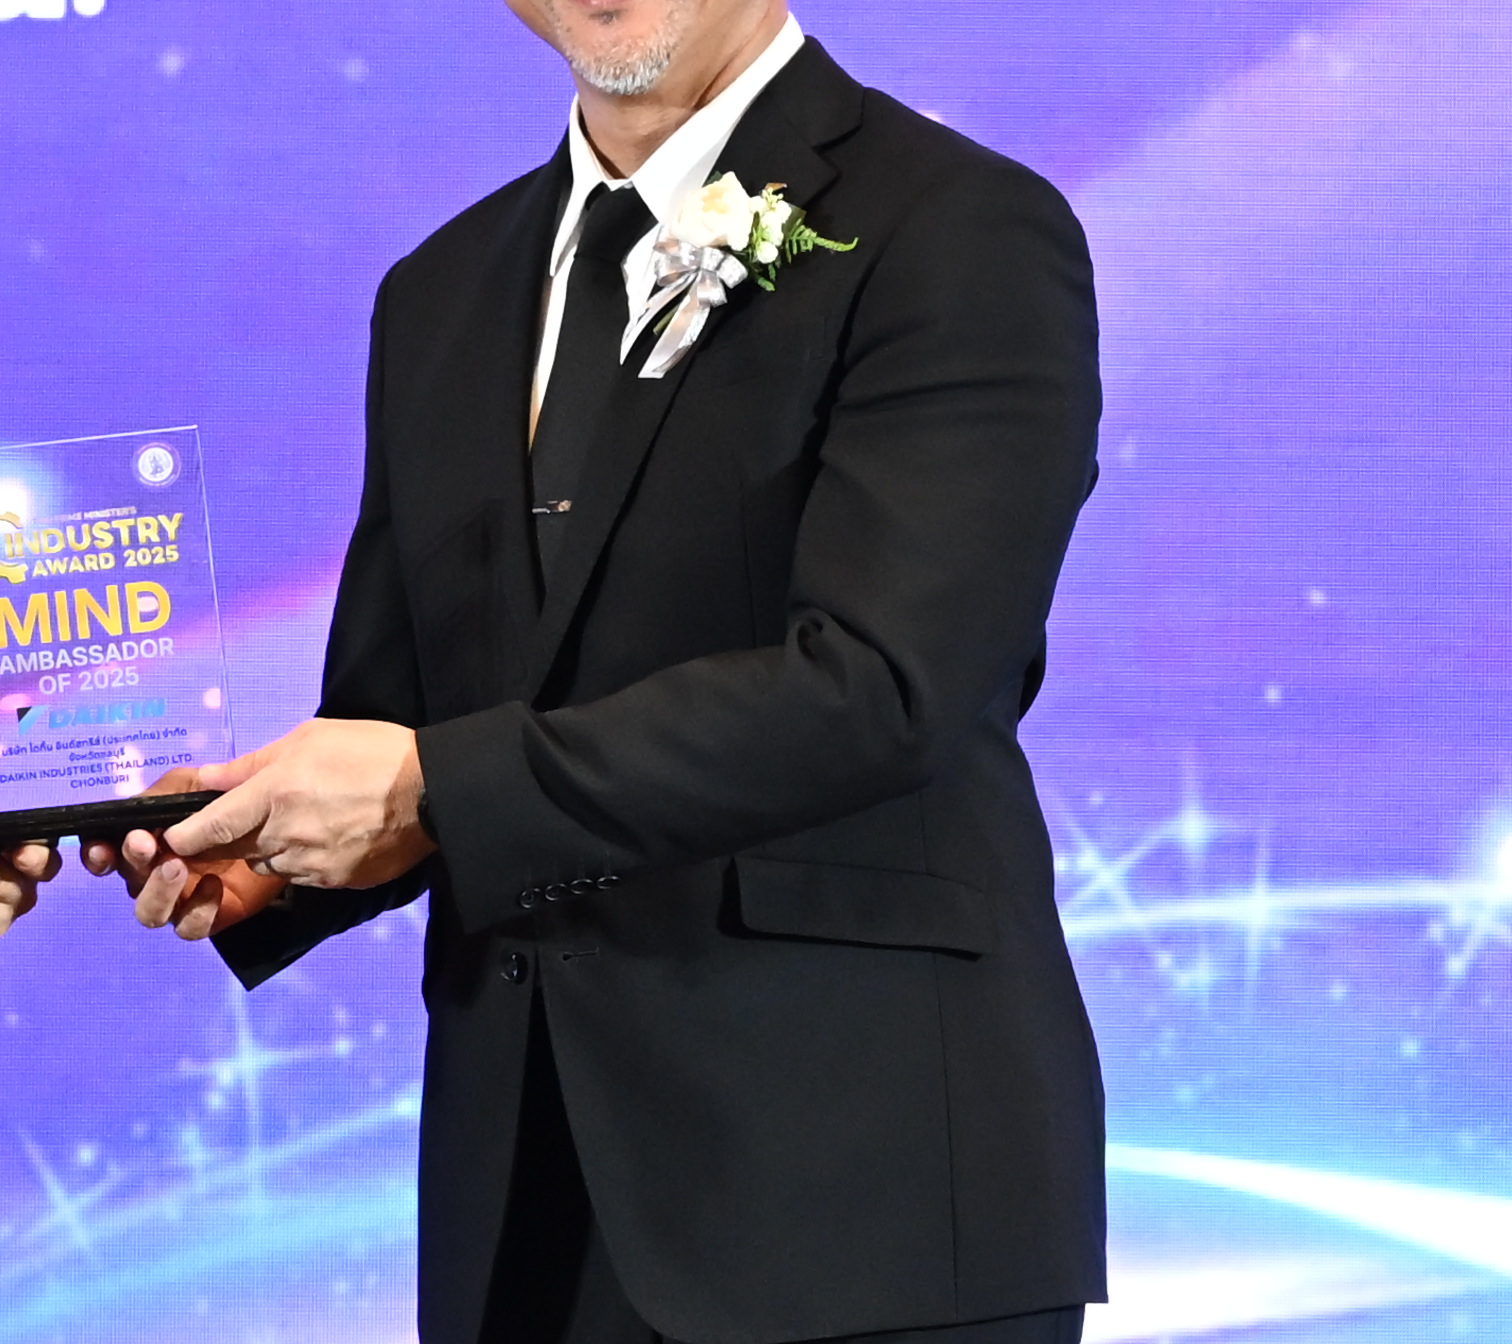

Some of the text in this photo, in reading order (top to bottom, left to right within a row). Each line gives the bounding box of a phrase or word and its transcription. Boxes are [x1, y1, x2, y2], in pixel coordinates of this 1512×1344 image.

[4, 513, 184, 558] INDUSTRY
[32, 544, 180, 577] AWARD 2025
[38, 666, 140, 695] OF 2025
[48, 697, 167, 729] DAIKIN
